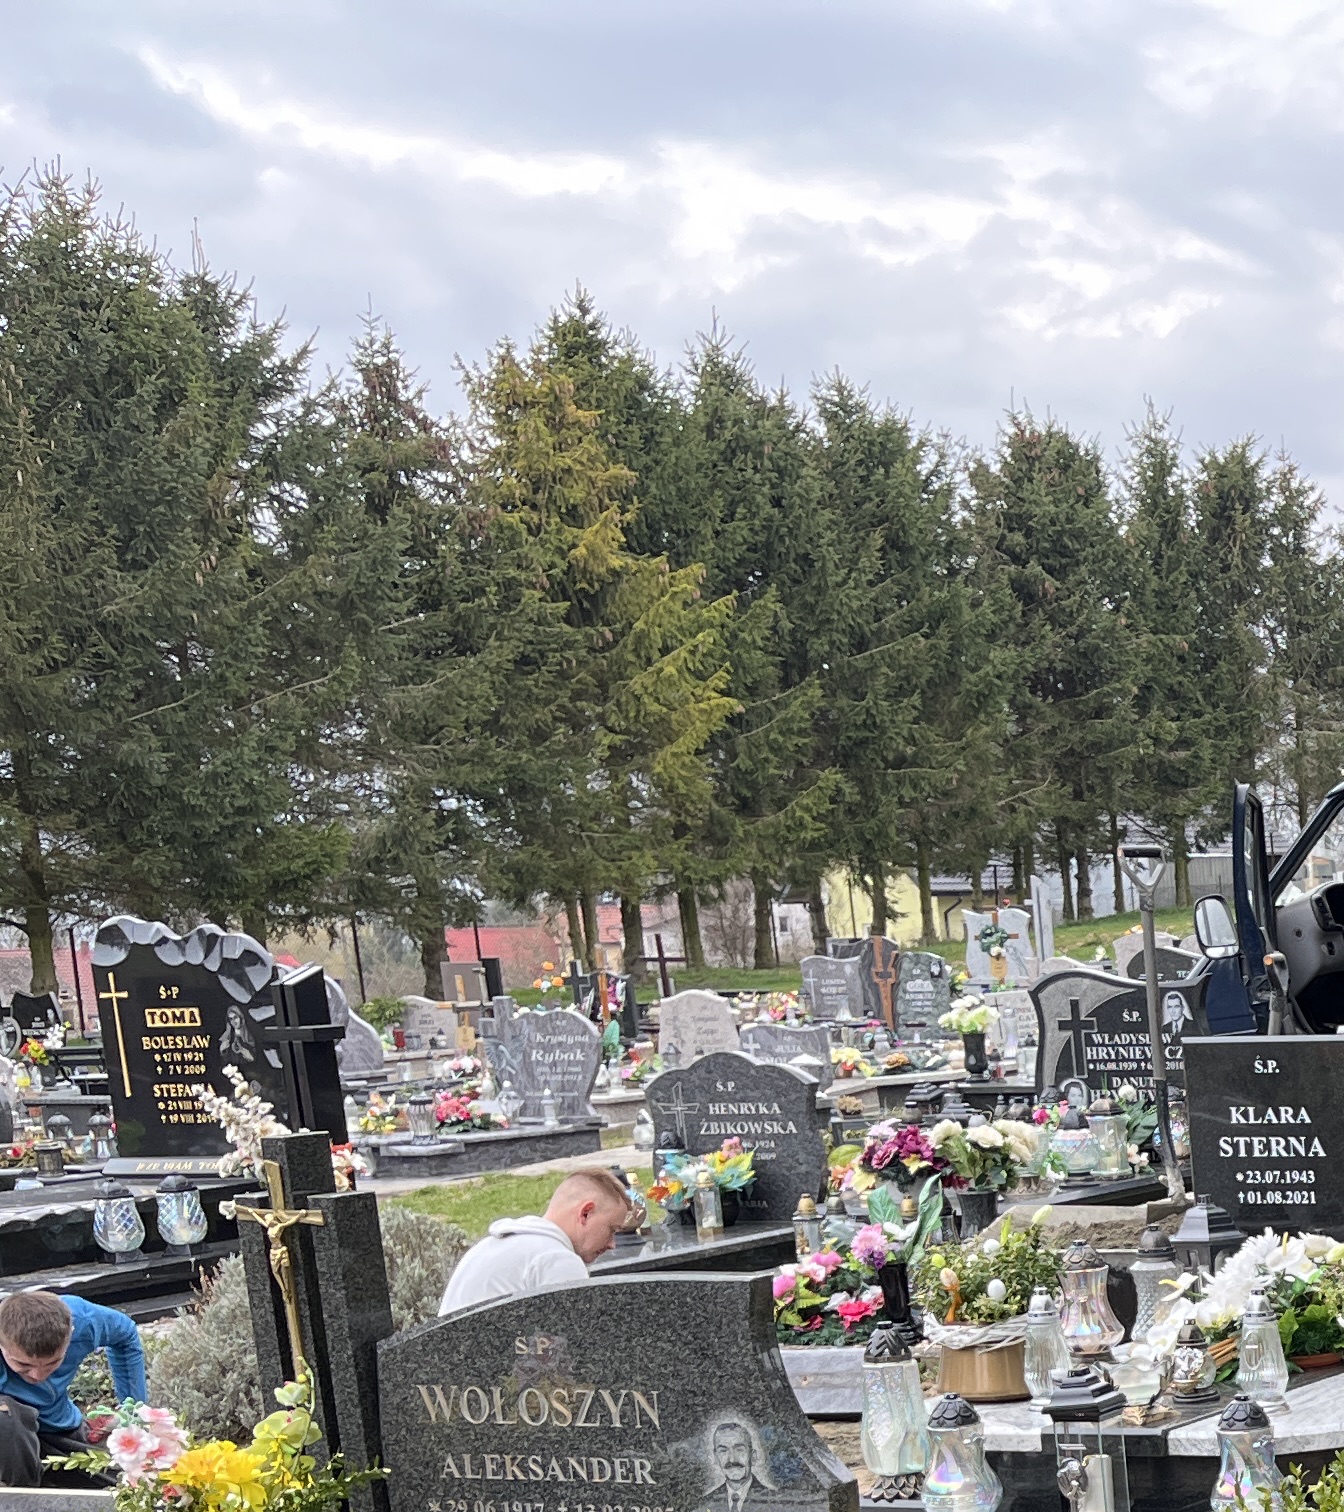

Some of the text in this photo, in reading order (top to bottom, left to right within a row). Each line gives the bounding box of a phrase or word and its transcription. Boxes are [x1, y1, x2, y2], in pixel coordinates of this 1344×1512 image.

[147, 1010, 198, 1024] TOMA
[142, 1034, 210, 1050] BOLESŁAW
[531, 1048, 586, 1064] Rybak
[1254, 1054, 1280, 1073] Ś.P.
[708, 1102, 782, 1115] HENRYKA
[1229, 1106, 1312, 1124] KLARA
[1218, 1136, 1327, 1157] STERNA
[1246, 1170, 1316, 1184] 23.07.1943
[1247, 1190, 1317, 1205] 01.08.2021
[415, 1384, 661, 1430] WOŁOSZYN
[440, 1453, 657, 1485] ALEKSANDER
